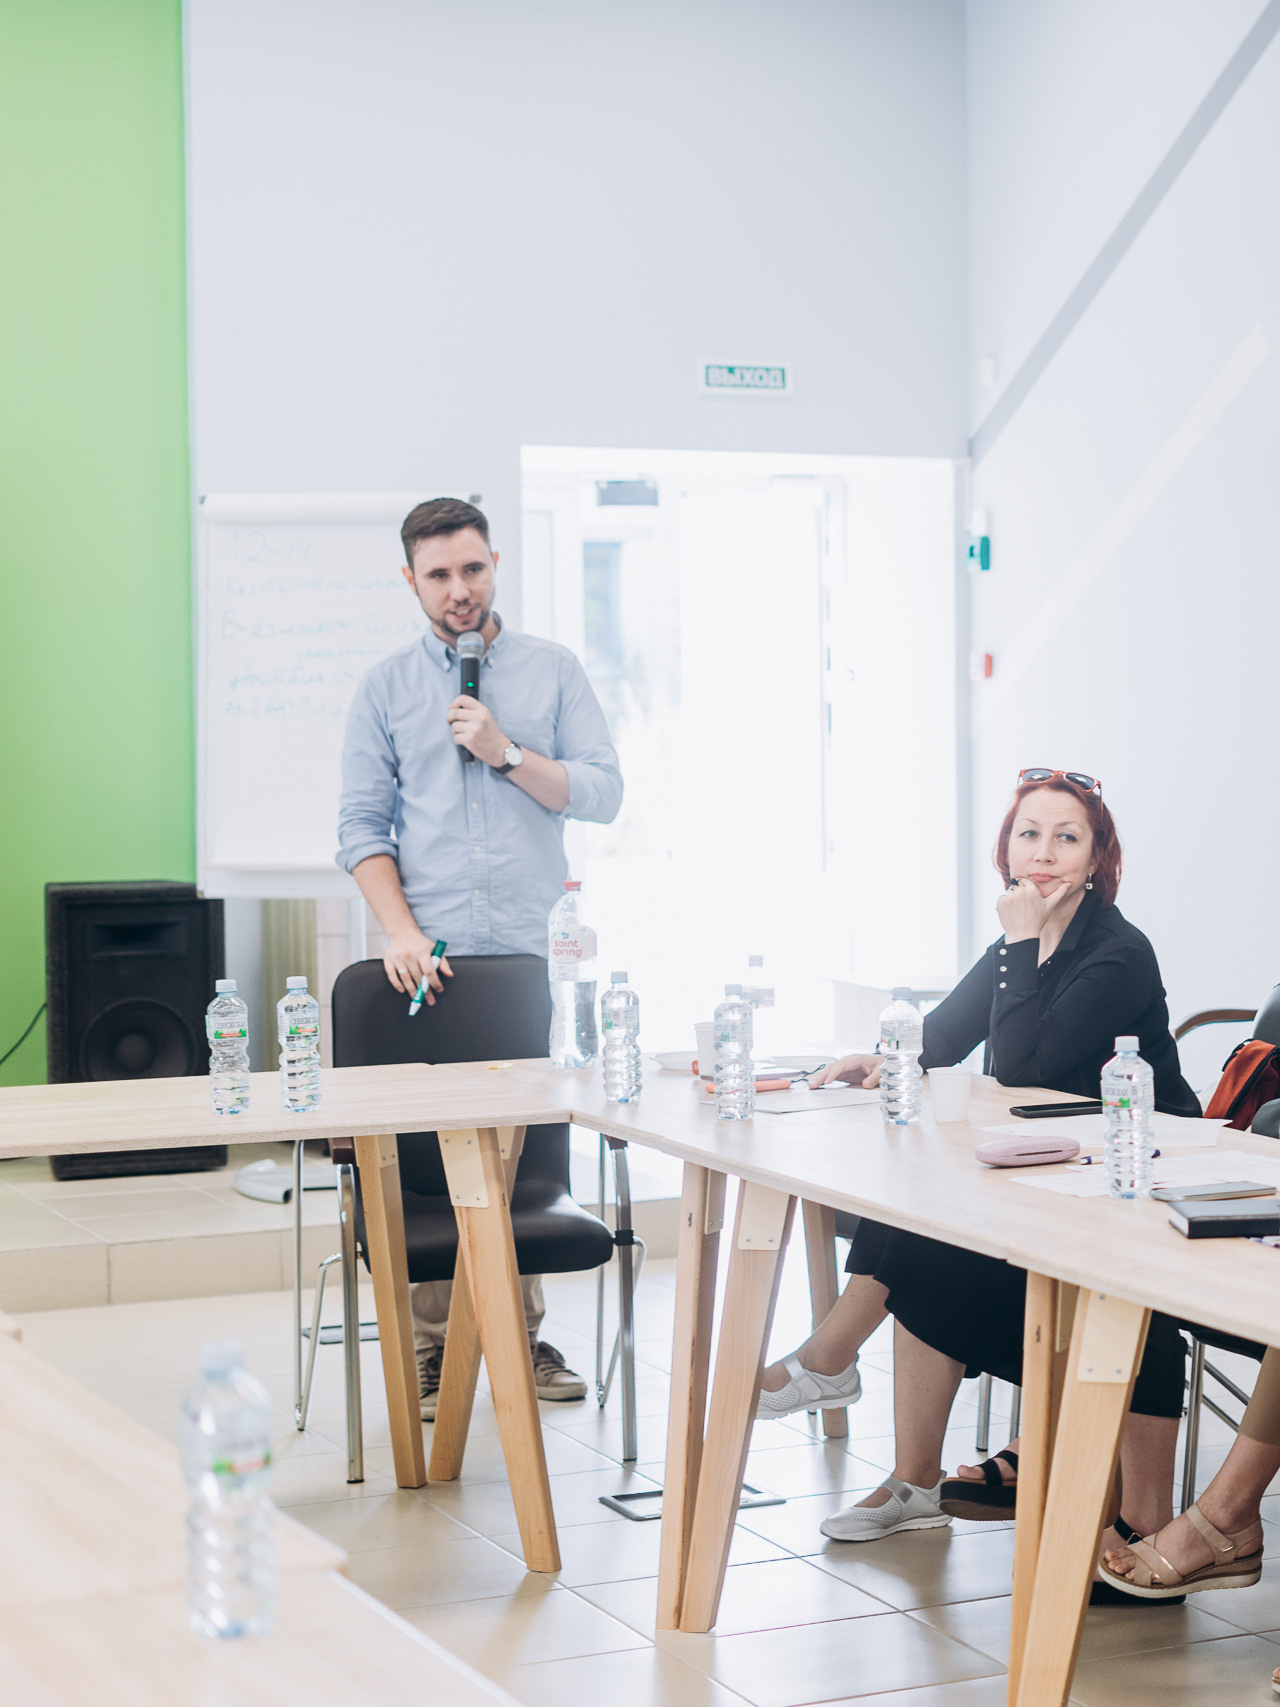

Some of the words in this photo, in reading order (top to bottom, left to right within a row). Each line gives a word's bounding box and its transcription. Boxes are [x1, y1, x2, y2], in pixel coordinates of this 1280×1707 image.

[707, 365, 783, 387] ВЫХОД
[554, 939, 579, 948] saint
[552, 948, 582, 959] spring
